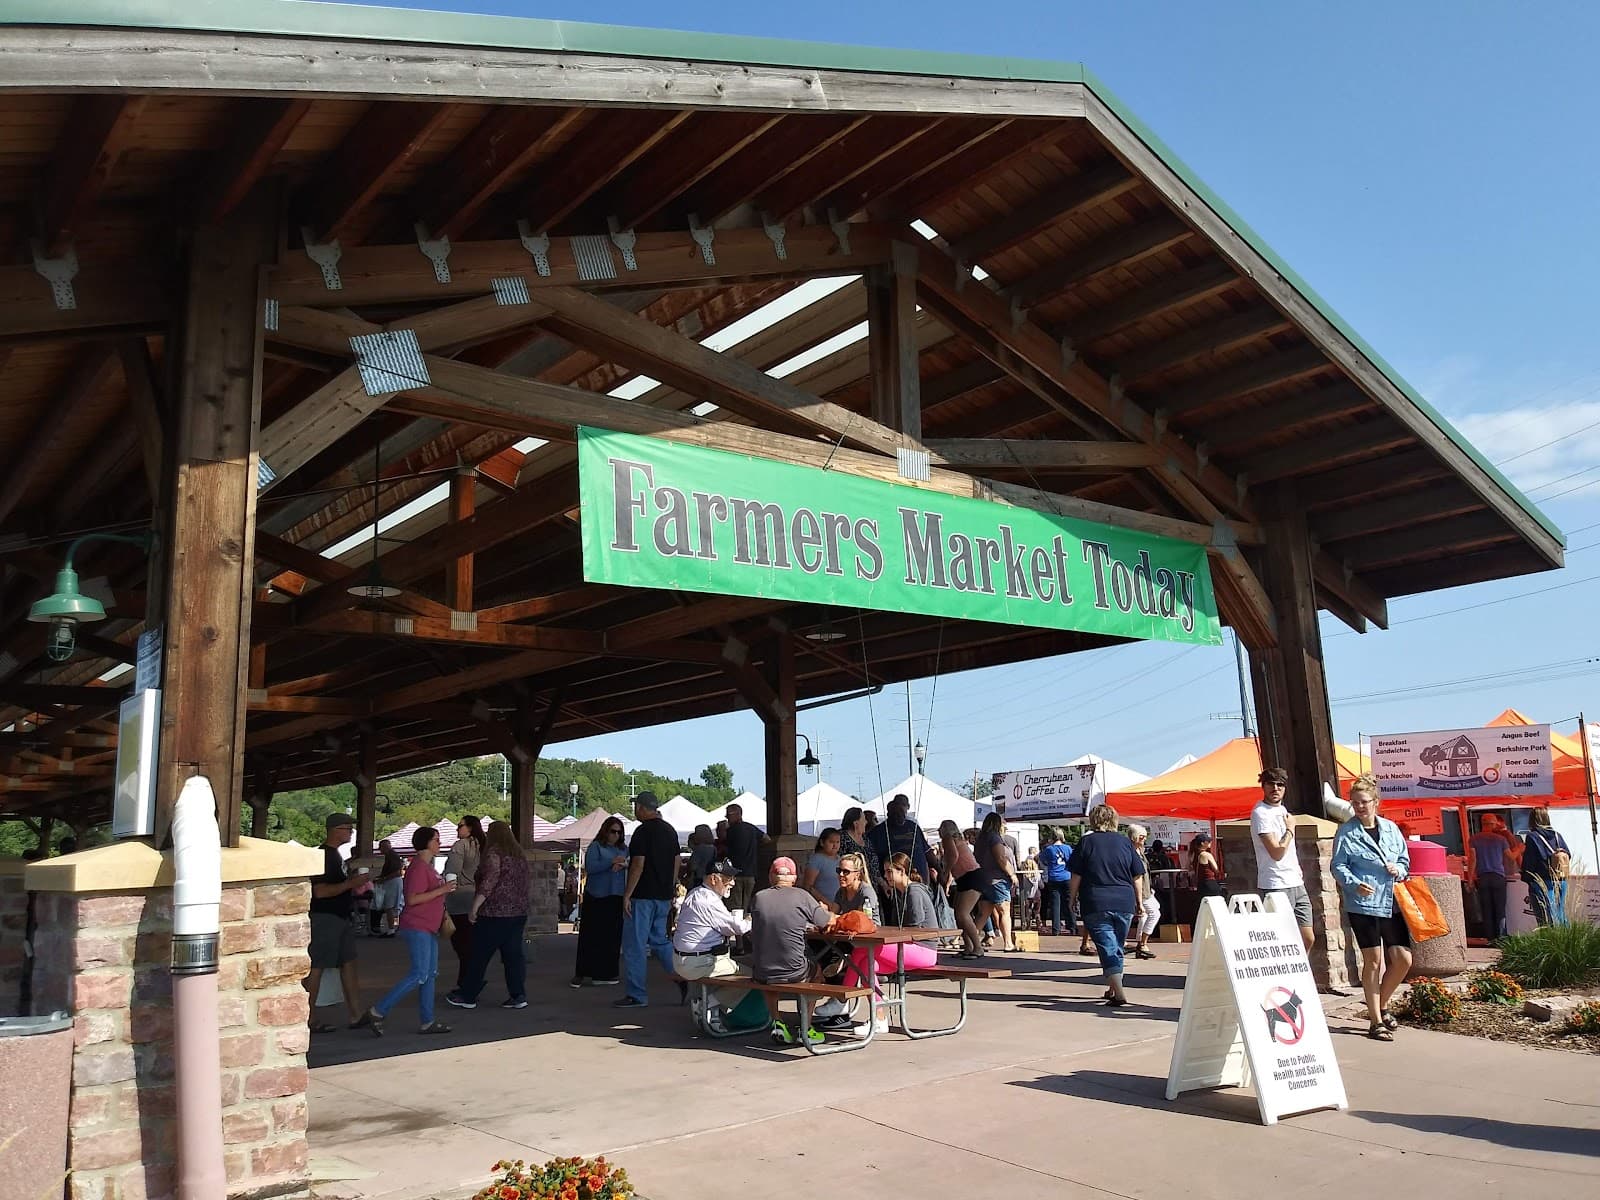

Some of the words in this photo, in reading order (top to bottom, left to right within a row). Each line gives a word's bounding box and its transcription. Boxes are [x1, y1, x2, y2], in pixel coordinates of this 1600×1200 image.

[608, 457, 885, 582] Farmers
[897, 506, 1074, 607] Market
[1081, 539, 1196, 634] Today
[1502, 732, 1522, 740] Angus
[1024, 773, 1073, 785] Cherrybean
[1026, 784, 1054, 796] Coffee
[1058, 784, 1070, 794] Co.
[1404, 808, 1424, 817] Grill
[1234, 948, 1246, 961] NO
[1246, 947, 1269, 960] DOGS
[1270, 946, 1280, 958] OR
[1282, 944, 1300, 956] PETS
[1235, 968, 1244, 980] in
[1246, 966, 1260, 978] the
[1261, 964, 1290, 976] market
[1290, 962, 1308, 973] area
[1277, 1058, 1290, 1068] Due
[1290, 1057, 1298, 1066] to
[1298, 1054, 1316, 1064] Public
[1273, 1069, 1294, 1080] Health
[1294, 1067, 1307, 1077] and
[1307, 1064, 1326, 1075] Safety
[1288, 1078, 1318, 1090] Concerns
